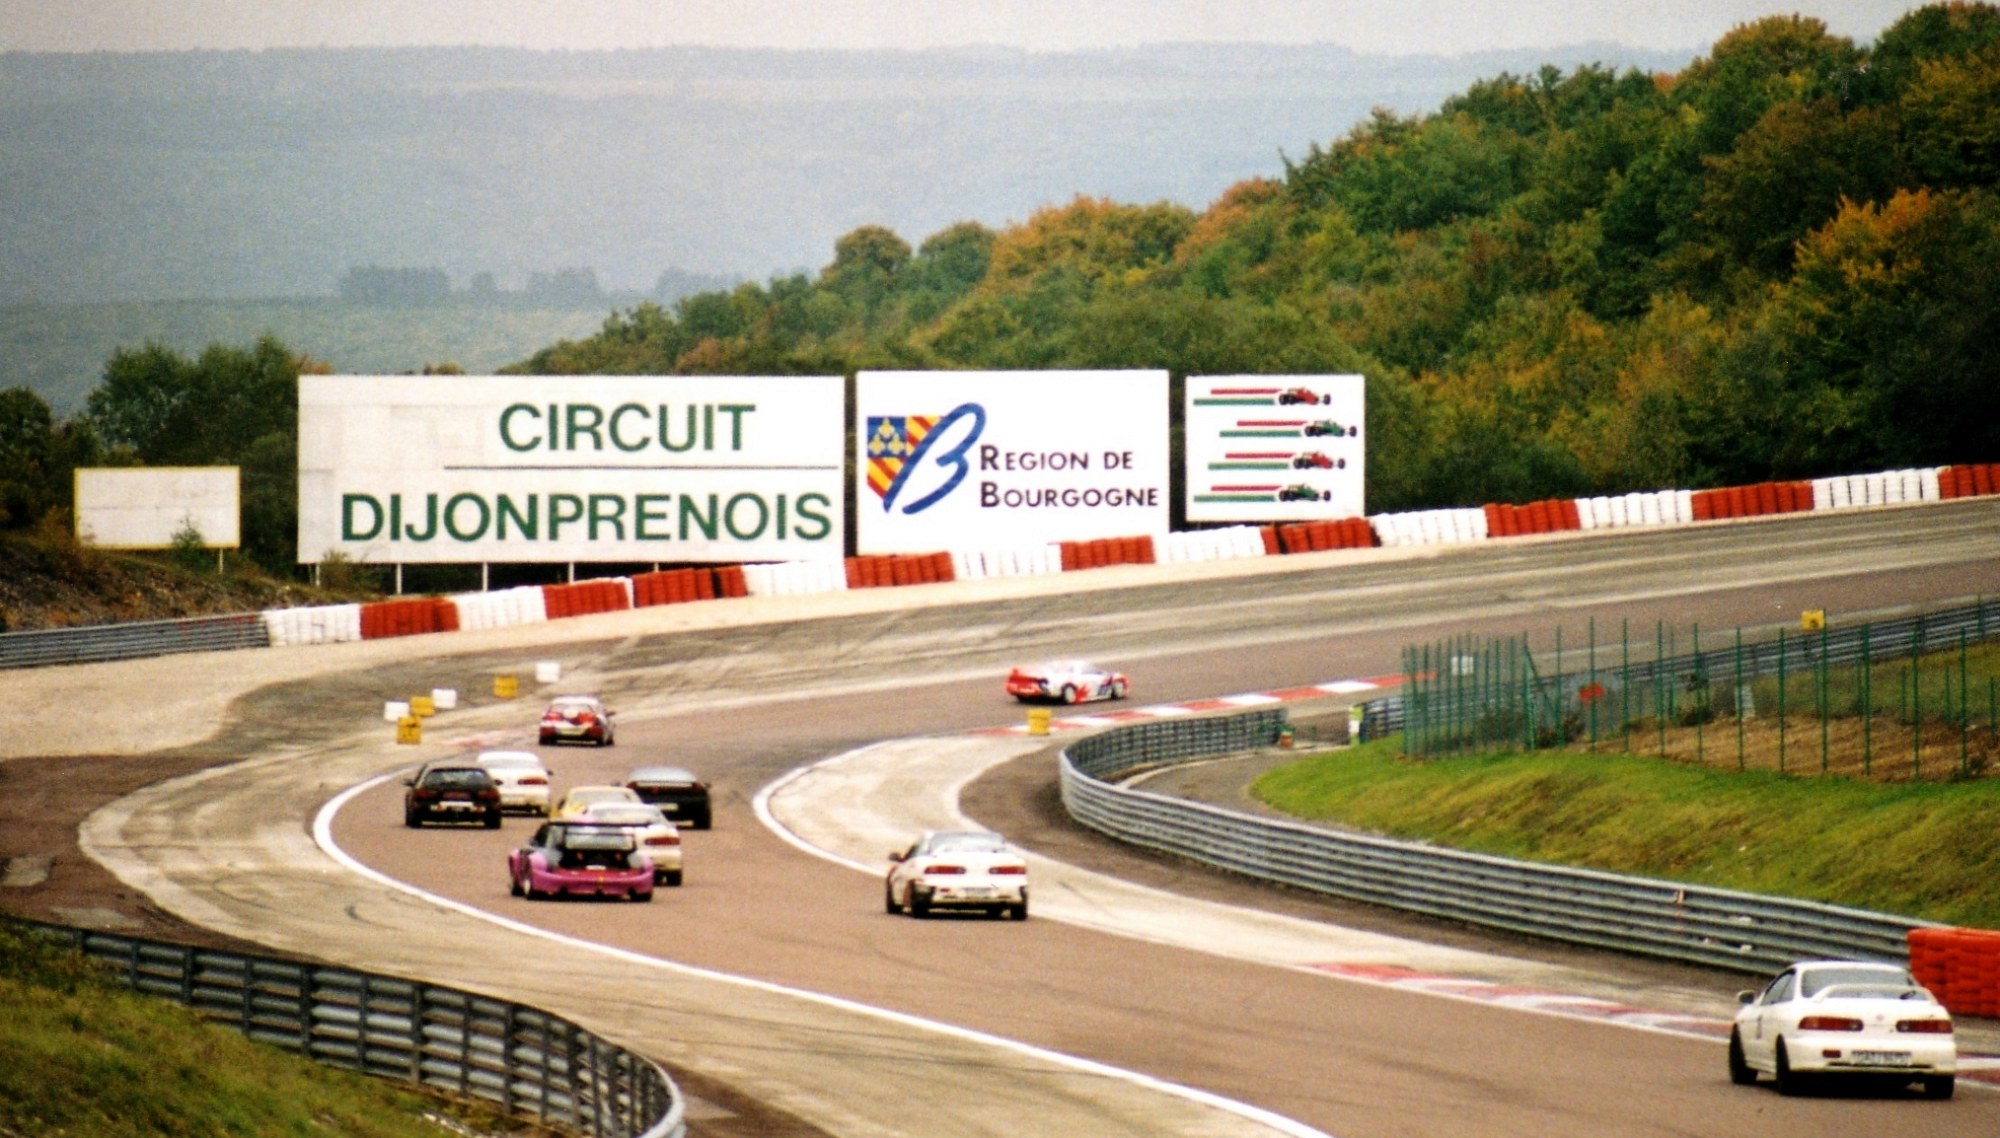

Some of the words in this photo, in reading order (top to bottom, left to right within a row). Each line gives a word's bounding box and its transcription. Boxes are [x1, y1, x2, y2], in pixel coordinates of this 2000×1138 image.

[499, 402, 756, 452] CIRCUIT
[980, 445, 1089, 471] REGION
[1104, 452, 1133, 470] DE
[980, 482, 1160, 508] BOURGOGNE
[341, 491, 832, 543] DIJONPRENOIS
